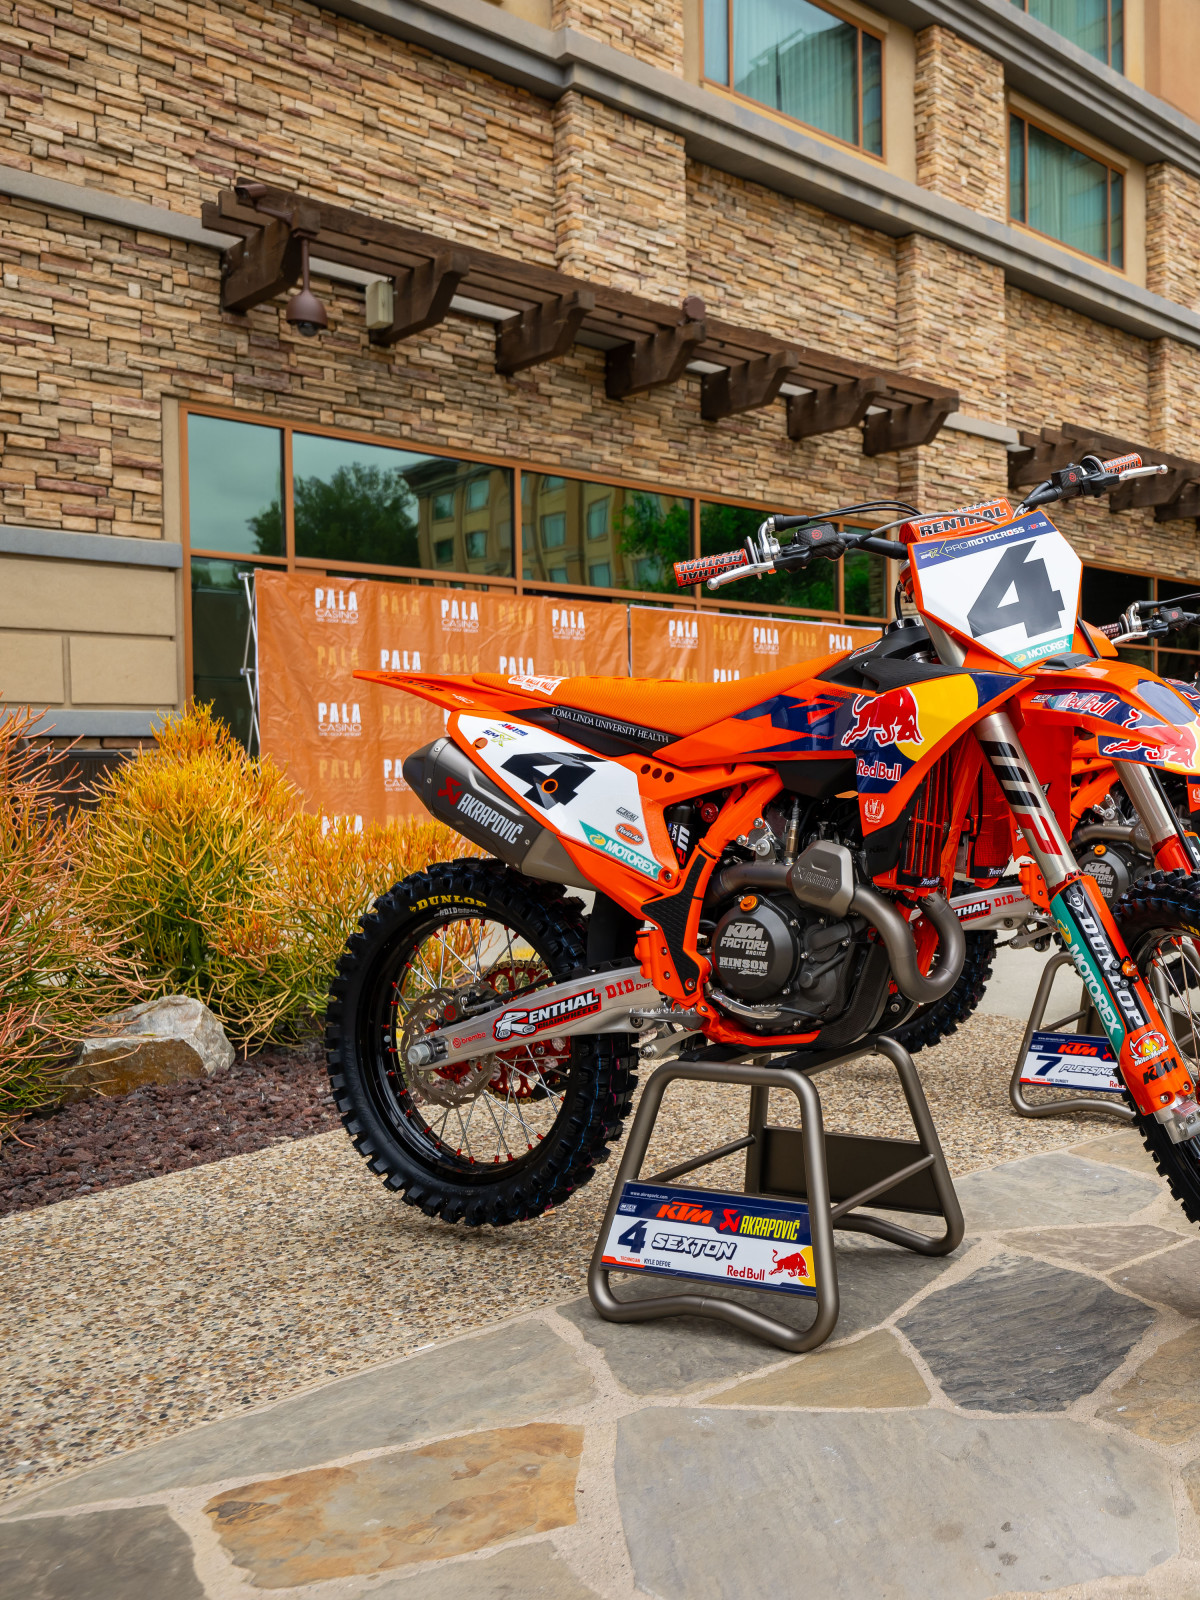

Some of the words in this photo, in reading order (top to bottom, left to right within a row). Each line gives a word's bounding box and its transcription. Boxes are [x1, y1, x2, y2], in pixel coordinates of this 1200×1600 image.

[966, 540, 1066, 638] 4
[314, 588, 358, 611] PALA
[380, 594, 420, 616] PALA
[441, 599, 479, 620] PALA
[315, 609, 359, 620] CASINO
[441, 619, 480, 629] CASINO
[552, 609, 585, 629] PALA
[552, 627, 585, 637] CASINO
[669, 620, 698, 638] PALA
[753, 627, 779, 644] PALA
[829, 634, 853, 649] PALA
[1027, 637, 1070, 660] MOTOREX
[380, 649, 421, 670] PALA
[500, 656, 534, 675] PALA
[318, 702, 361, 724] PALA
[1060, 692, 1085, 709] Red
[1084, 696, 1119, 717] Bull
[318, 723, 362, 733] CASINO
[551, 707, 571, 720] LOMA
[572, 711, 594, 726] LINDA
[595, 717, 638, 736] UNIVERSITY
[637, 729, 669, 743] HEALTH
[384, 759, 403, 779] PA
[857, 759, 878, 777] Red
[877, 763, 902, 782] Bull
[500, 752, 608, 811] 4
[457, 792, 525, 845] AKRAPOVIČ
[617, 825, 633, 838] Twin
[630, 833, 643, 843] Air
[604, 840, 657, 876] MOTOREX
[416, 894, 487, 911] DUNLOP
[725, 922, 765, 940] KTM
[720, 936, 769, 952] FACTORY
[719, 956, 769, 970] HINSON
[1071, 943, 1122, 1035] MOTOREX
[537, 1004, 600, 1030] CHAINWHEELS
[461, 1032, 487, 1045] brembo
[1057, 1042, 1099, 1057] KTM
[1034, 1055, 1063, 1077] 7
[1058, 1064, 1115, 1078] PLESSING
[1143, 1057, 1178, 1085] KTM
[656, 1201, 714, 1224] KTM
[740, 1215, 800, 1241] AKRAPOVIČ
[617, 1220, 649, 1254] 4
[651, 1232, 738, 1261] SEXTON
[643, 1258, 655, 1266] KYLE
[655, 1259, 672, 1268] DEFOE
[727, 1264, 747, 1280] Red
[746, 1267, 765, 1281] Bull
